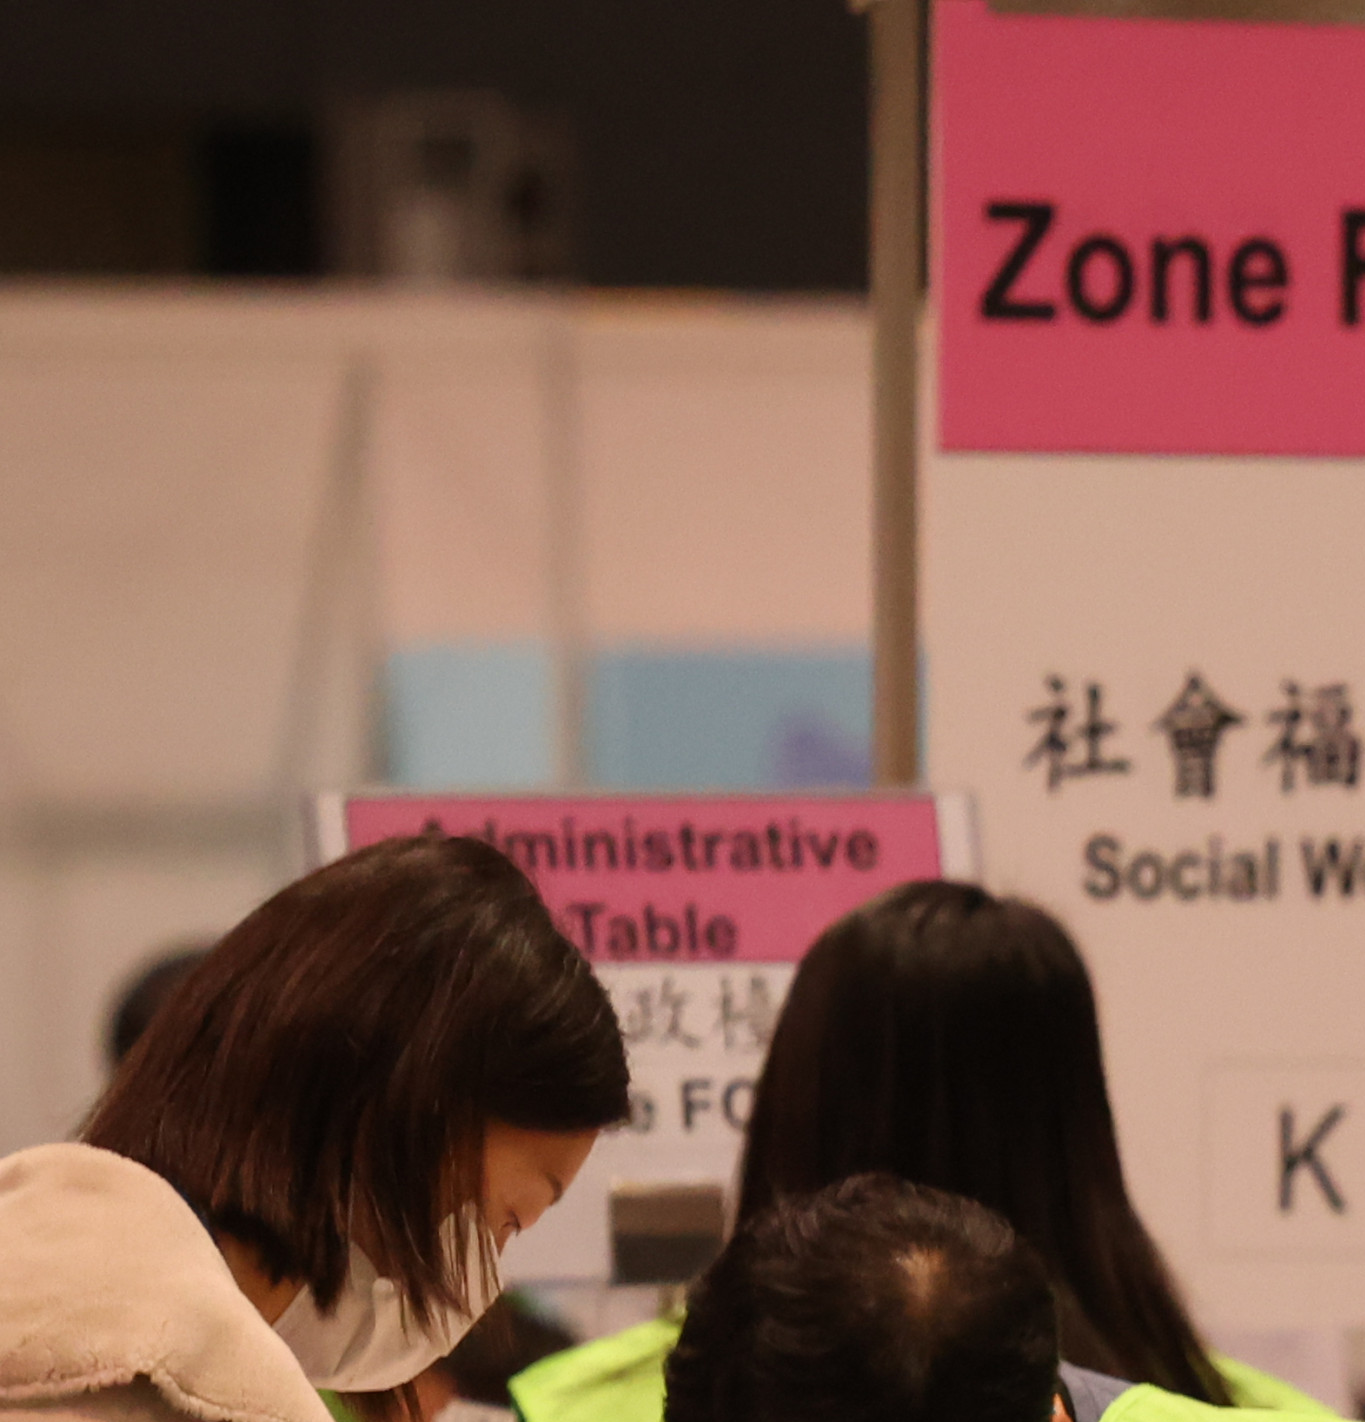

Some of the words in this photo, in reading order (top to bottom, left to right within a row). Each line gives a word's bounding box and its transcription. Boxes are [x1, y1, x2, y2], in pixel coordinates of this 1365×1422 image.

[981, 201, 1290, 326] Zone
[421, 816, 880, 874] ministrative
[1083, 834, 1280, 905] Social
[567, 902, 738, 958] Table
[1274, 1103, 1348, 1217] K
